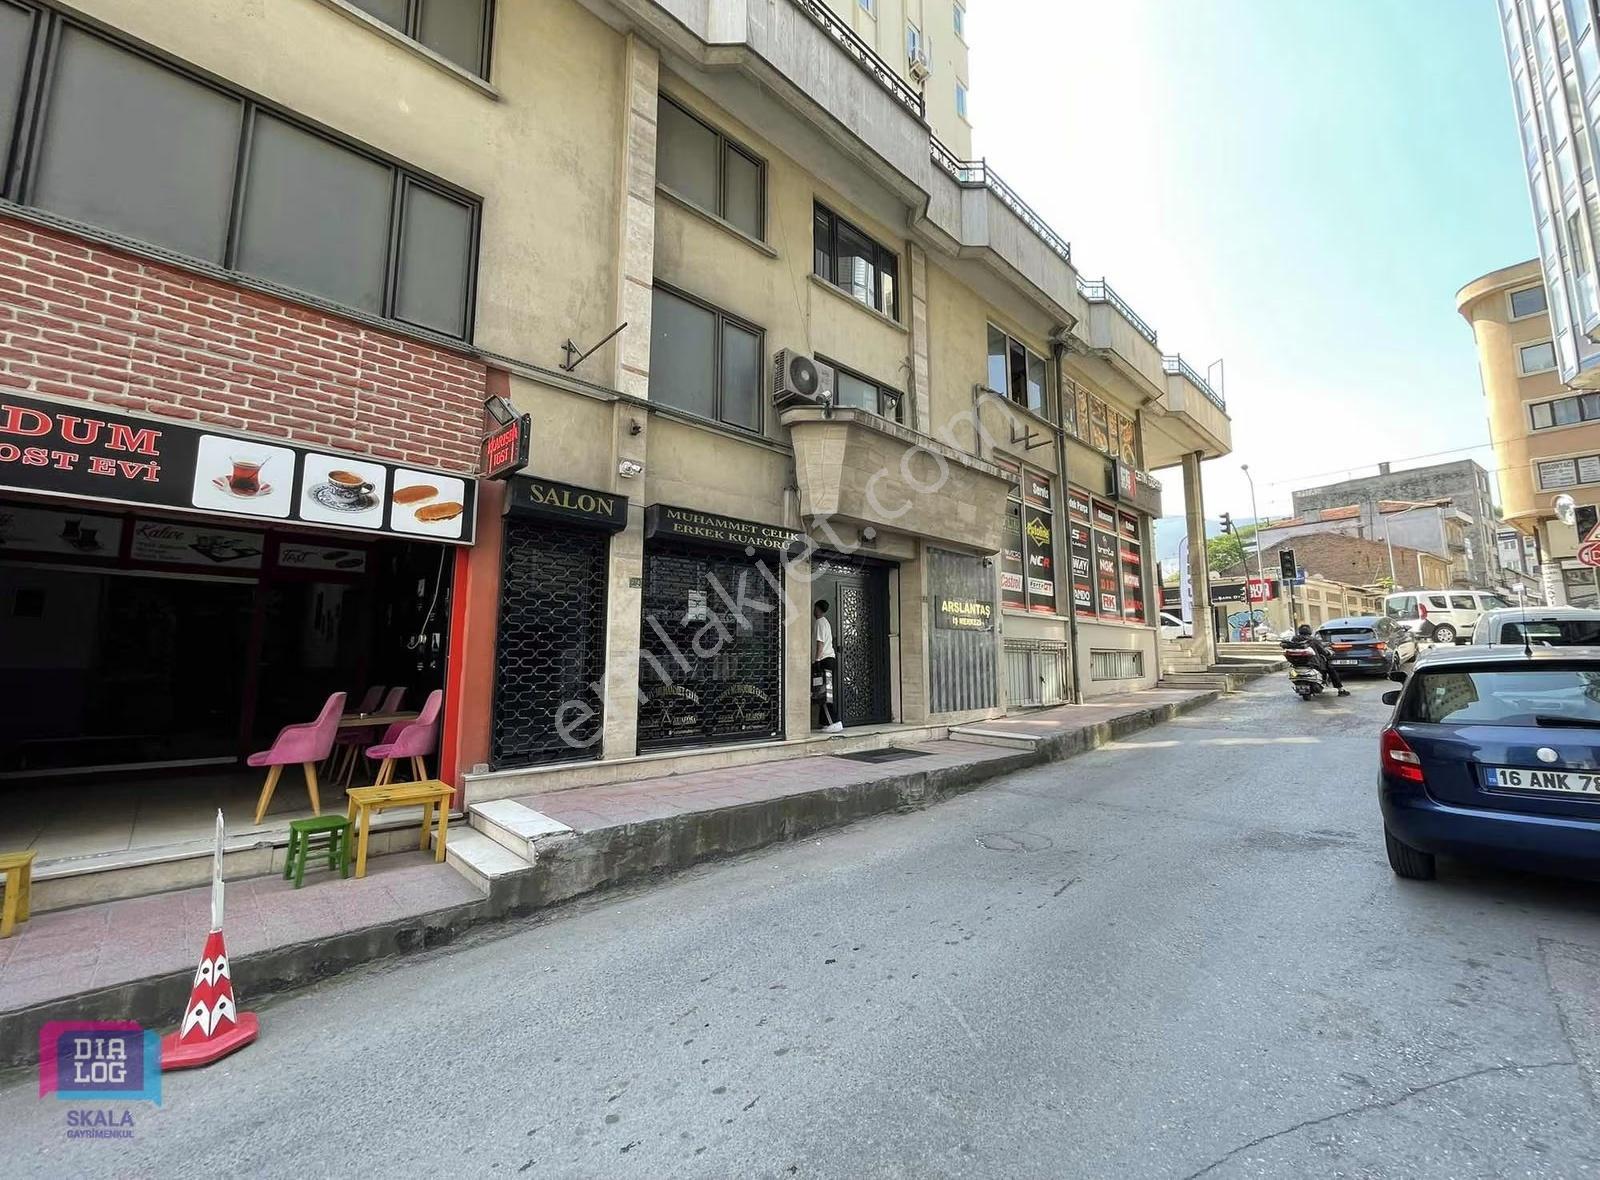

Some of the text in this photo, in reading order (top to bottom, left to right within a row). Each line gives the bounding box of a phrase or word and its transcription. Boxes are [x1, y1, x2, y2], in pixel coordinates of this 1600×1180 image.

[1, 404, 163, 456] DUM
[88, 456, 162, 483] EVİ
[529, 483, 615, 516] SALON
[667, 509, 759, 533] MUHAMMET
[673, 523, 725, 539] ERKEK
[941, 600, 991, 618] ARSLANTAŞ
[1499, 770, 1522, 786] 16
[1529, 771, 1571, 790] ANK
